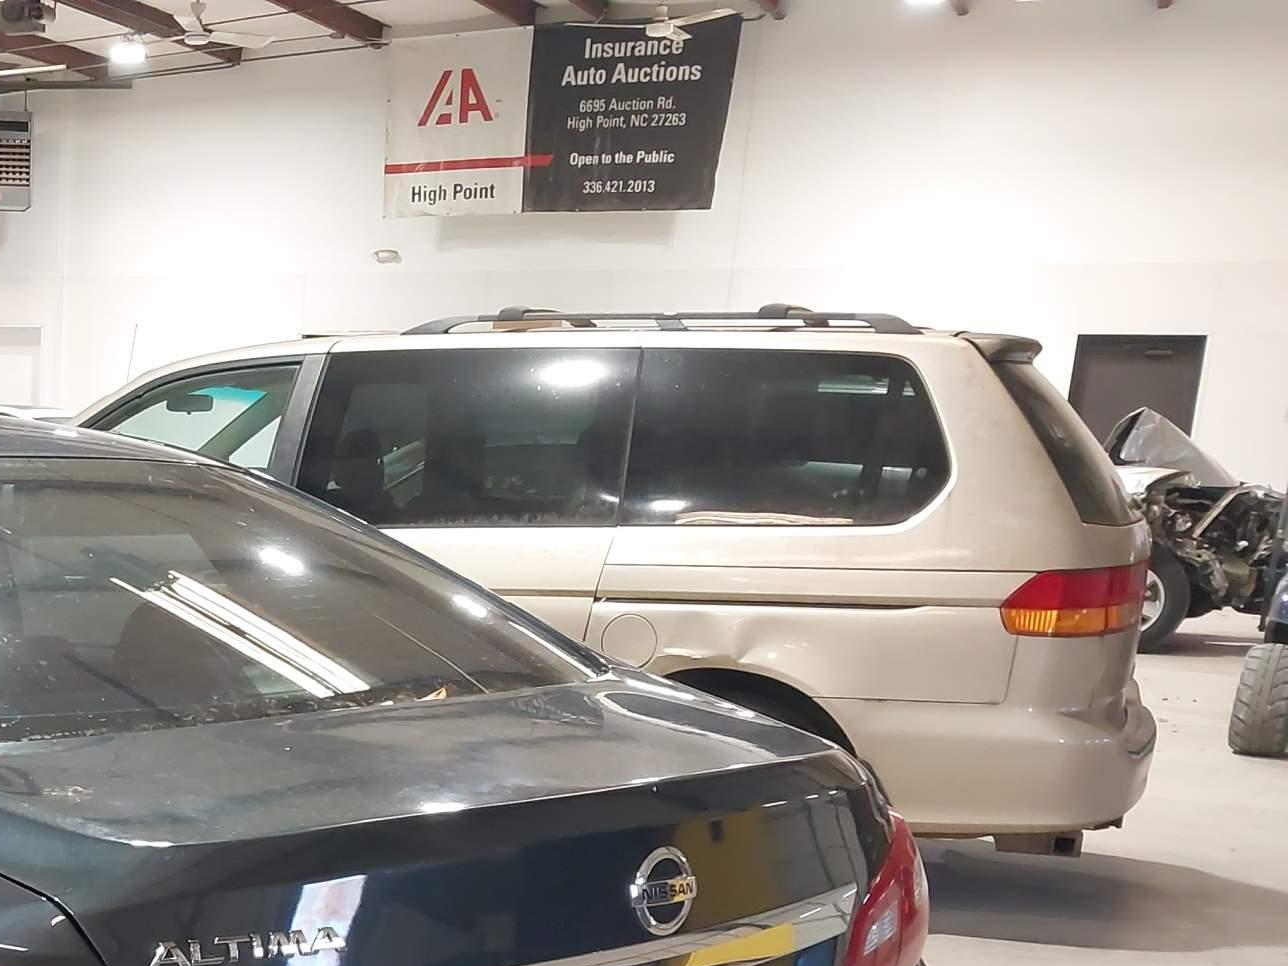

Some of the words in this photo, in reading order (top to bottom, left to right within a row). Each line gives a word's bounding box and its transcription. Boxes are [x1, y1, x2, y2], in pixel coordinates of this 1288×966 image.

[584, 38, 684, 59] Insurance
[561, 65, 607, 87] Auto
[611, 61, 703, 84] Auctions
[579, 99, 606, 113] 6695
[608, 97, 654, 111] Auction
[656, 95, 677, 110] Rd.
[567, 116, 593, 132] High
[596, 114, 627, 129] Point,
[630, 113, 649, 128] NC
[651, 112, 687, 127] 27263
[569, 152, 599, 168] Open
[601, 153, 612, 165] to
[614, 151, 634, 164] the
[636, 150, 675, 164] Public
[411, 184, 447, 206] High
[453, 182, 496, 200] Point
[582, 179, 656, 194] 336.421.2013
[642, 883, 694, 900] NISSAN
